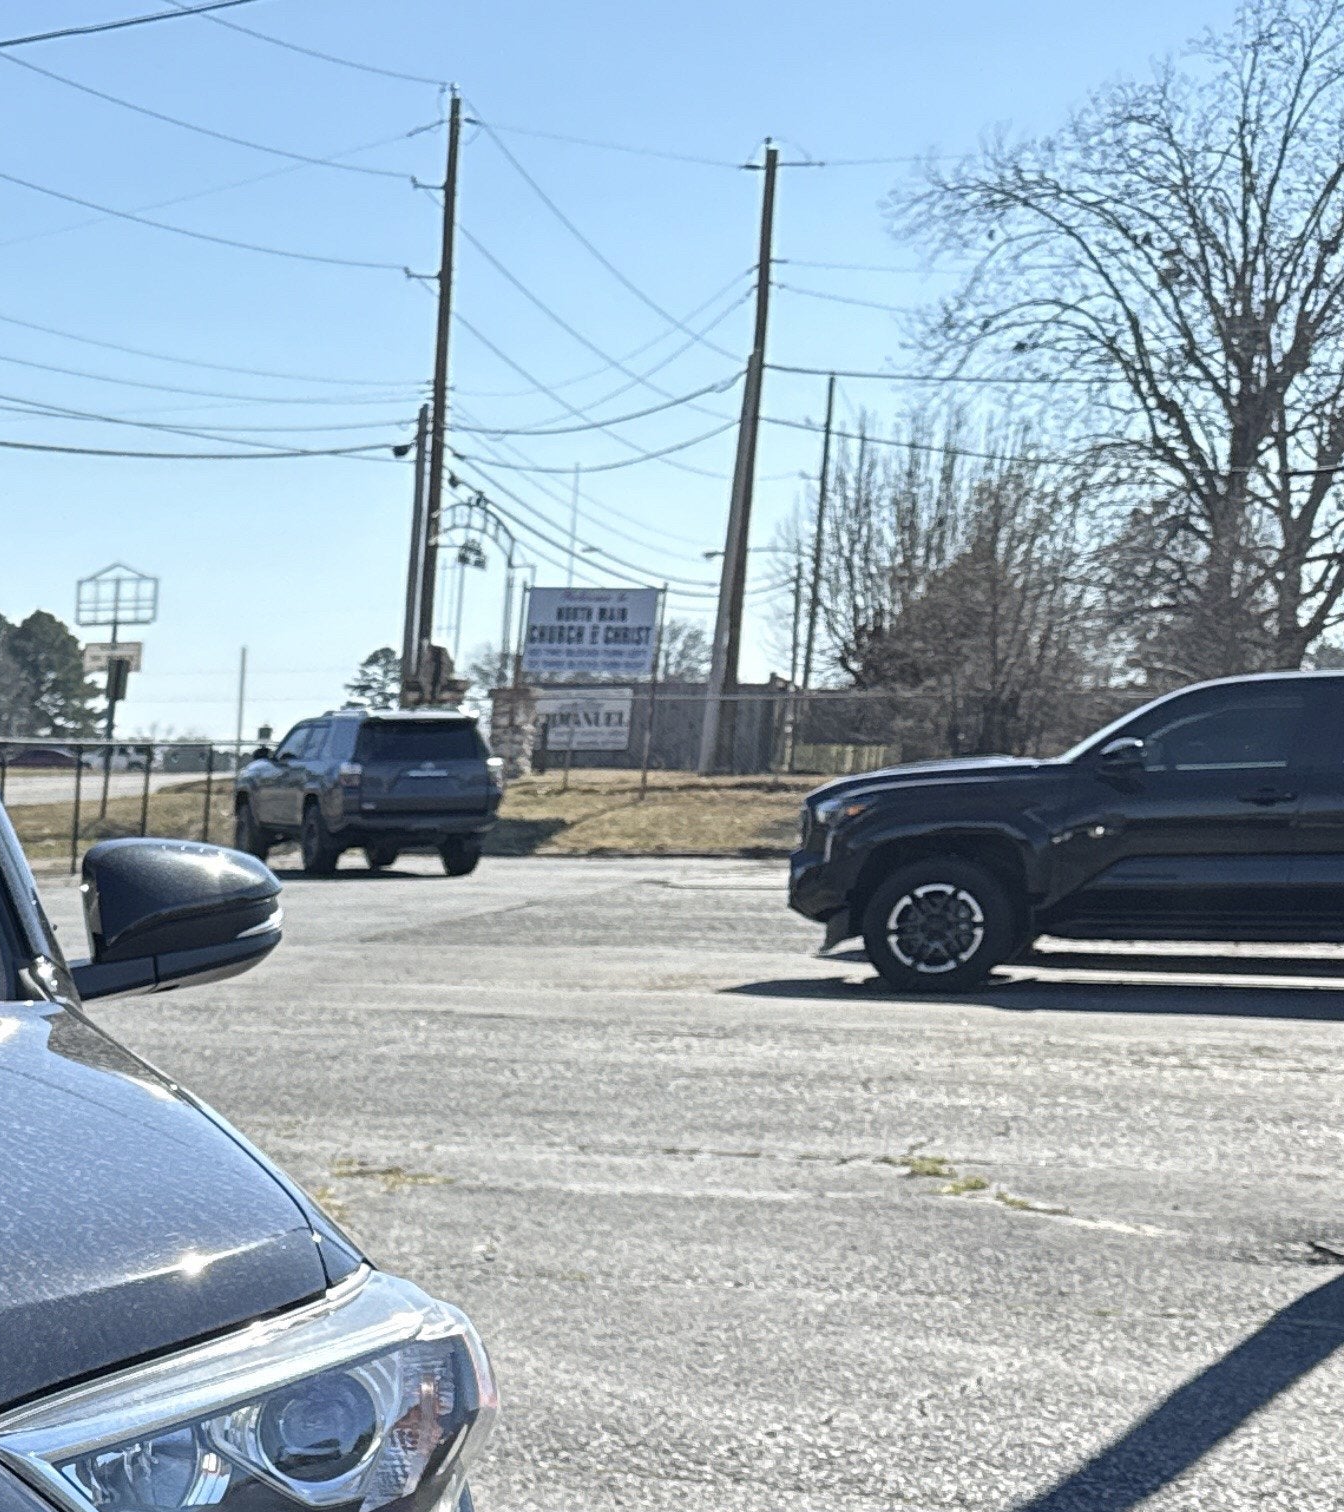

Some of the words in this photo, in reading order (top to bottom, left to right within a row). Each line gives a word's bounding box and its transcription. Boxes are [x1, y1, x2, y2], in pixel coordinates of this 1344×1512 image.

[556, 606, 592, 622] NORTH
[598, 606, 628, 622] MAIN
[528, 624, 585, 645] CHURCH
[604, 625, 652, 645] CHRIST
